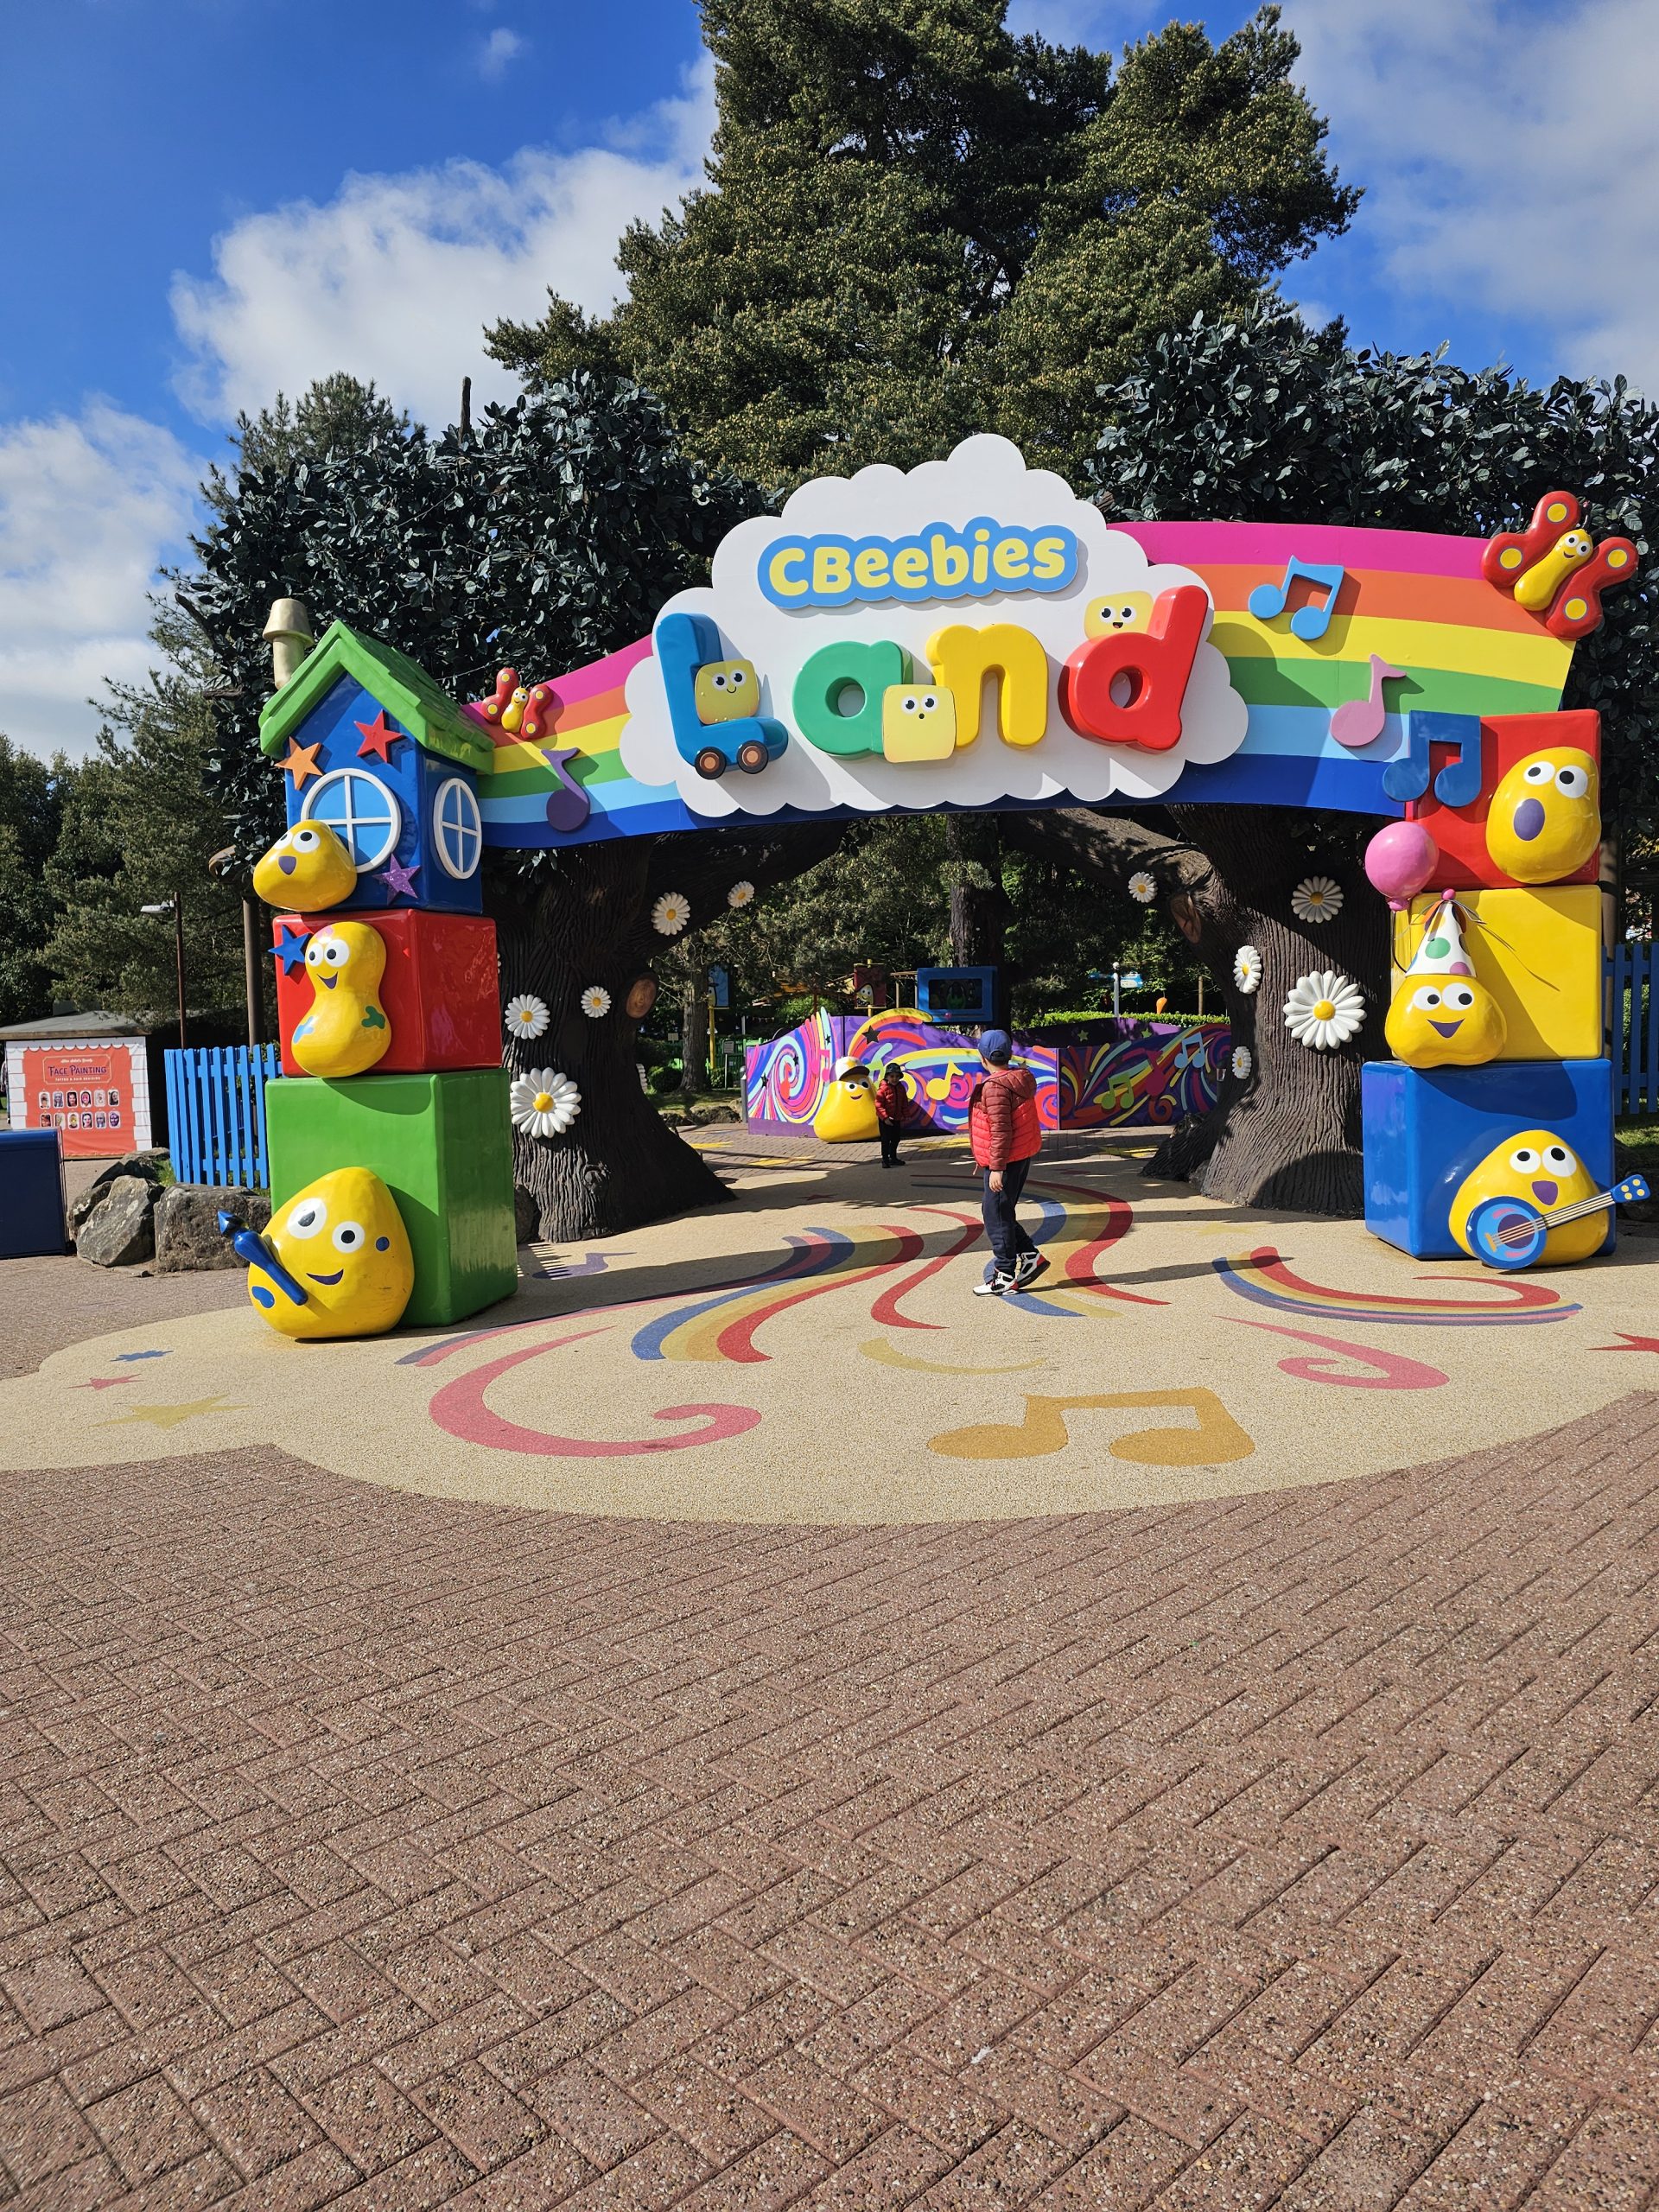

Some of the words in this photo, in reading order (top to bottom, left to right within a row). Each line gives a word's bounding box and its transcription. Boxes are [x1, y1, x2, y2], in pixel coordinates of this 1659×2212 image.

[768, 529, 1066, 598] CBeebies
[655, 585, 1209, 774] Land
[48, 1065, 67, 1077] FACE
[69, 1065, 107, 1076] PAINTING
